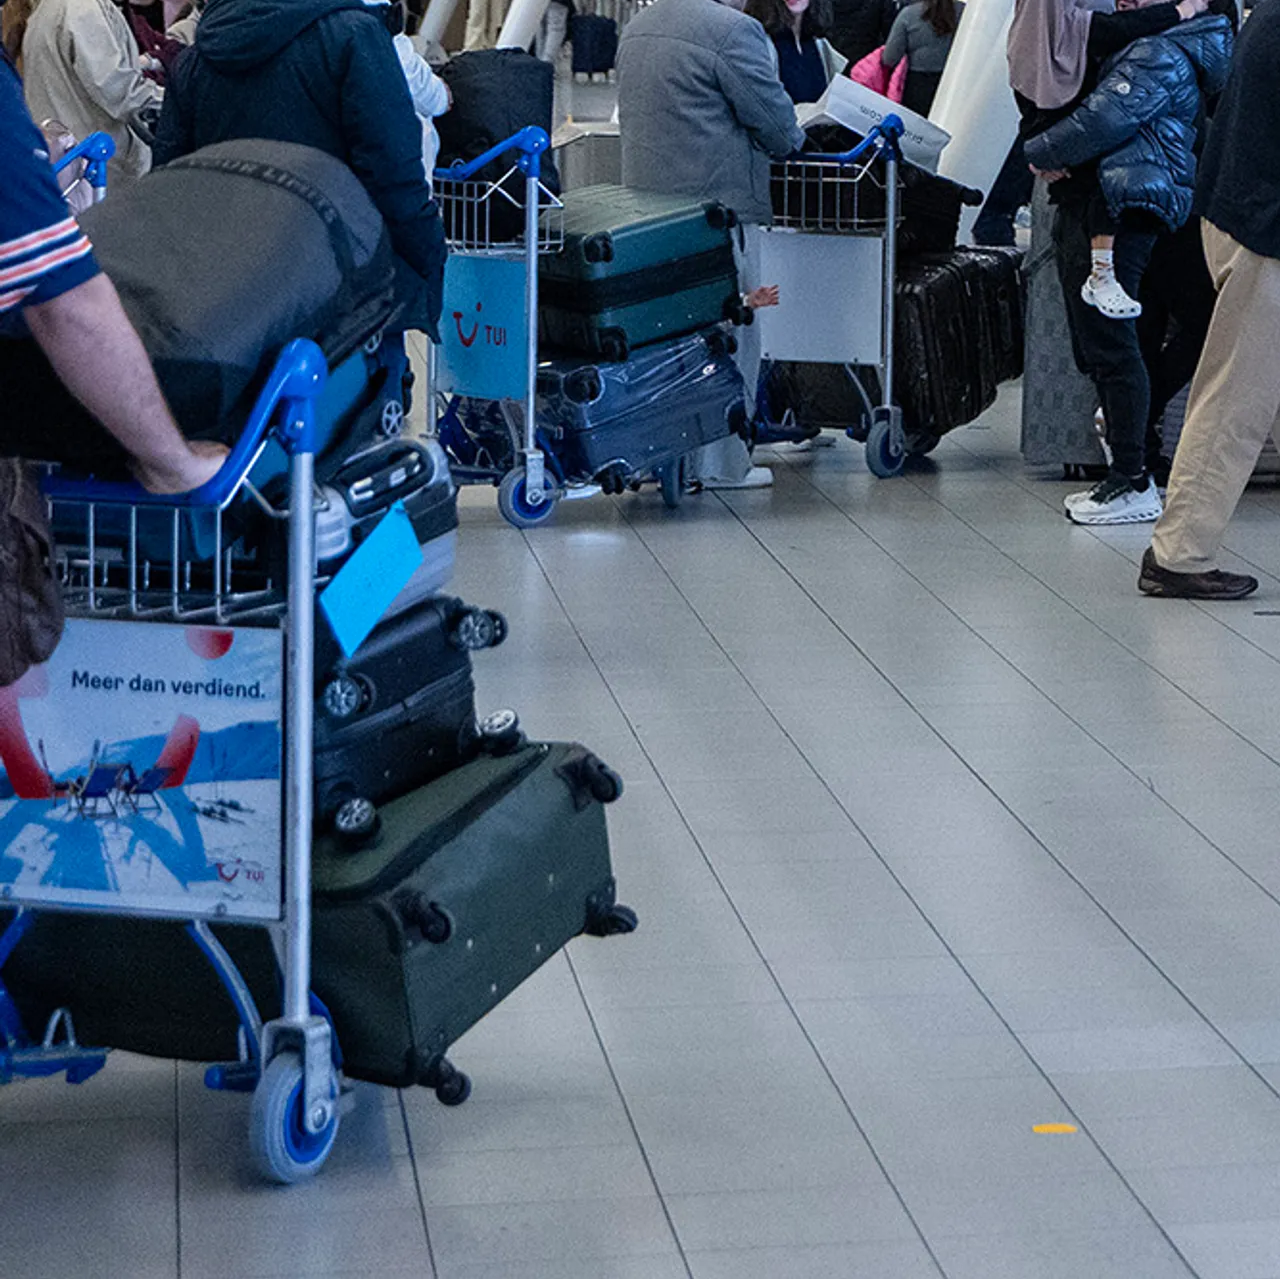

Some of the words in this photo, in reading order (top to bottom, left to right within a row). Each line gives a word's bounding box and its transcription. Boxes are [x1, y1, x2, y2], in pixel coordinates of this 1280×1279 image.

[484, 324, 507, 346] TUI
[71, 670, 124, 690] Meer
[128, 673, 166, 693] dan
[170, 677, 266, 699] verdiend.
